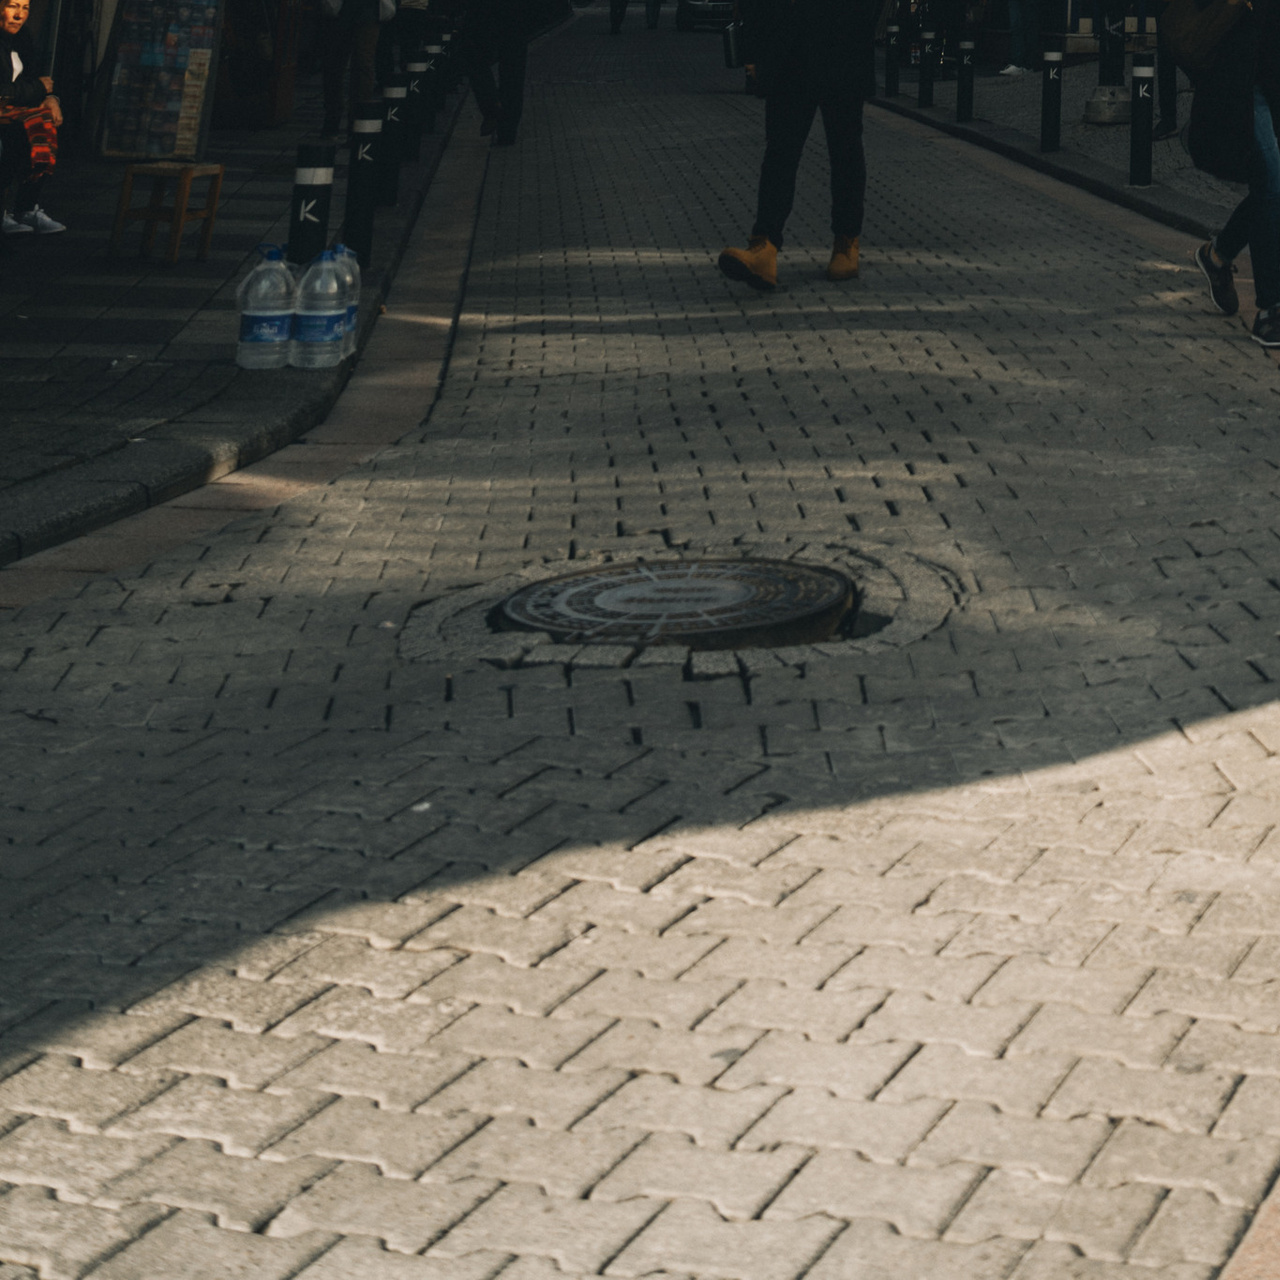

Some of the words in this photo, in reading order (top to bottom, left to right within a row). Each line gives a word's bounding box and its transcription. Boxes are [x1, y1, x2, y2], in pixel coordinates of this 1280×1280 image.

[963, 55, 972, 65] K
[1049, 68, 1059, 80] K
[410, 79, 420, 93] K
[1139, 83, 1151, 98] K
[387, 106, 400, 121] K
[358, 143, 373, 161] K
[300, 199, 320, 223] K
